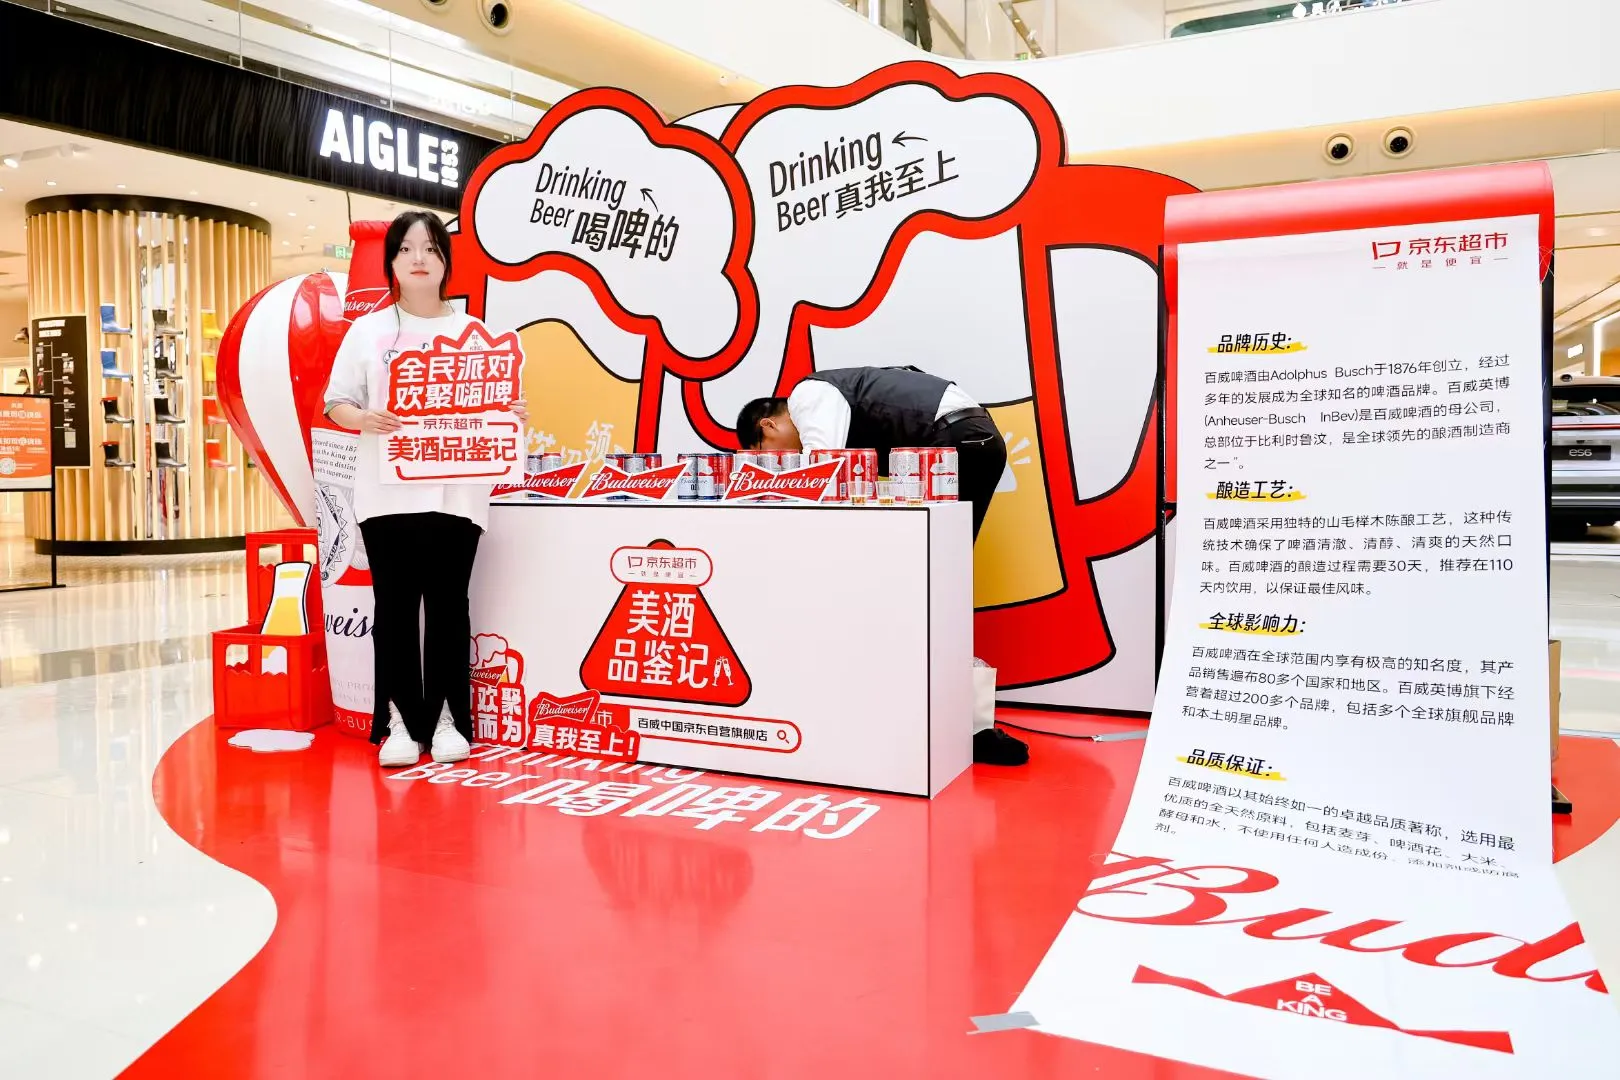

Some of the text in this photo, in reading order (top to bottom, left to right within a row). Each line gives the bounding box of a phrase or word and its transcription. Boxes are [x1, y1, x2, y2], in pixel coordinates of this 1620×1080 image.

[320, 108, 439, 183] AIGLE
[769, 132, 882, 197] Drinking
[535, 163, 627, 210] Drinking
[776, 150, 960, 232] Beer 真我至上
[530, 198, 680, 262] Beer 喝啤的
[1408, 232, 1509, 256] 京东超市
[344, 296, 373, 312] iser
[396, 353, 516, 384] 全民派对
[394, 381, 514, 410] 欢聚嗨啤
[1203, 375, 1511, 406] 多年的发展成为全球知名的啤酒品牌。百威英博
[423, 418, 484, 430] 京东超市
[1204, 412, 1306, 428] (Anheuser-Busch
[387, 435, 518, 463] 美酒品鉴记
[590, 471, 677, 491] Budweiser
[730, 470, 832, 492] Budweiser
[646, 556, 697, 569] 京东超市
[1199, 581, 1372, 596] 天内饮用，以保证最佳风味。
[325, 607, 374, 638] eis
[627, 589, 697, 638] 美酒
[469, 668, 502, 680] dweiser
[607, 638, 709, 689] 品鉴记
[470, 685, 522, 716] 欢聚
[536, 703, 590, 716] Budweiser
[471, 712, 522, 743] 而为
[637, 717, 768, 742] 百威中国京东自营旗舰店
[1181, 705, 1289, 730] 和本土明星品牌。
[385, 761, 881, 840] Beer 喝啤的
[1075, 852, 1609, 995] Bud
[1295, 980, 1332, 997] BE
[1301, 993, 1325, 1007] A
[1276, 998, 1348, 1021] KING
